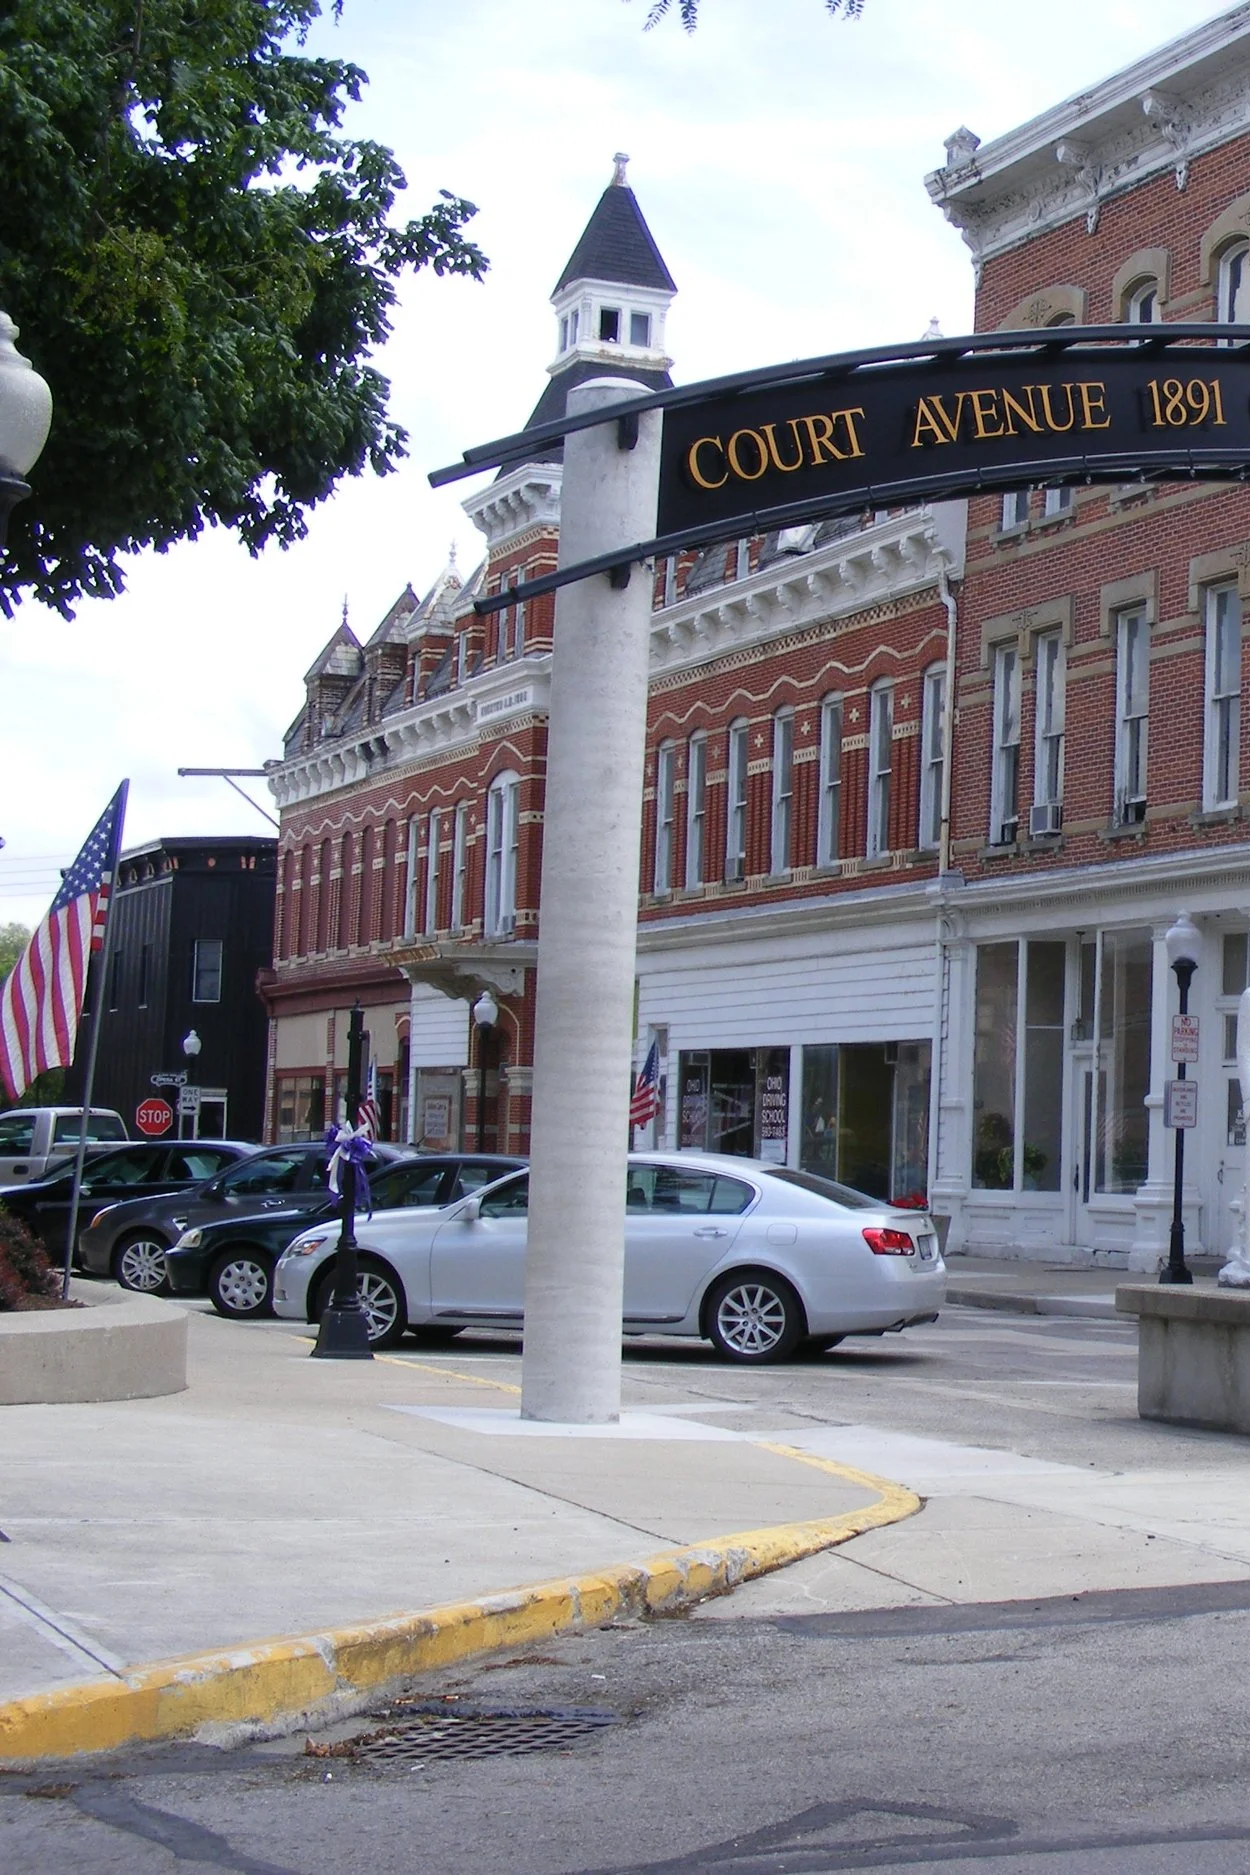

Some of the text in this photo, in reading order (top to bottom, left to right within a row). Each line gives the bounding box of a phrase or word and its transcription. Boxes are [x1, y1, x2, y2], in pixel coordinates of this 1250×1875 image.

[689, 407, 866, 490] COURT
[911, 381, 1112, 448] AVENUE
[1147, 379, 1227, 427] 1891
[1181, 1018, 1191, 1026] NO
[1174, 1027, 1198, 1036] PARKING
[687, 1079, 701, 1092] OHIO
[767, 1076, 783, 1090] OHIO
[182, 1088, 198, 1096] ONE
[763, 1093, 786, 1107] DRIVING
[140, 1109, 170, 1123] STOP
[762, 1109, 785, 1123] SCHOOL
